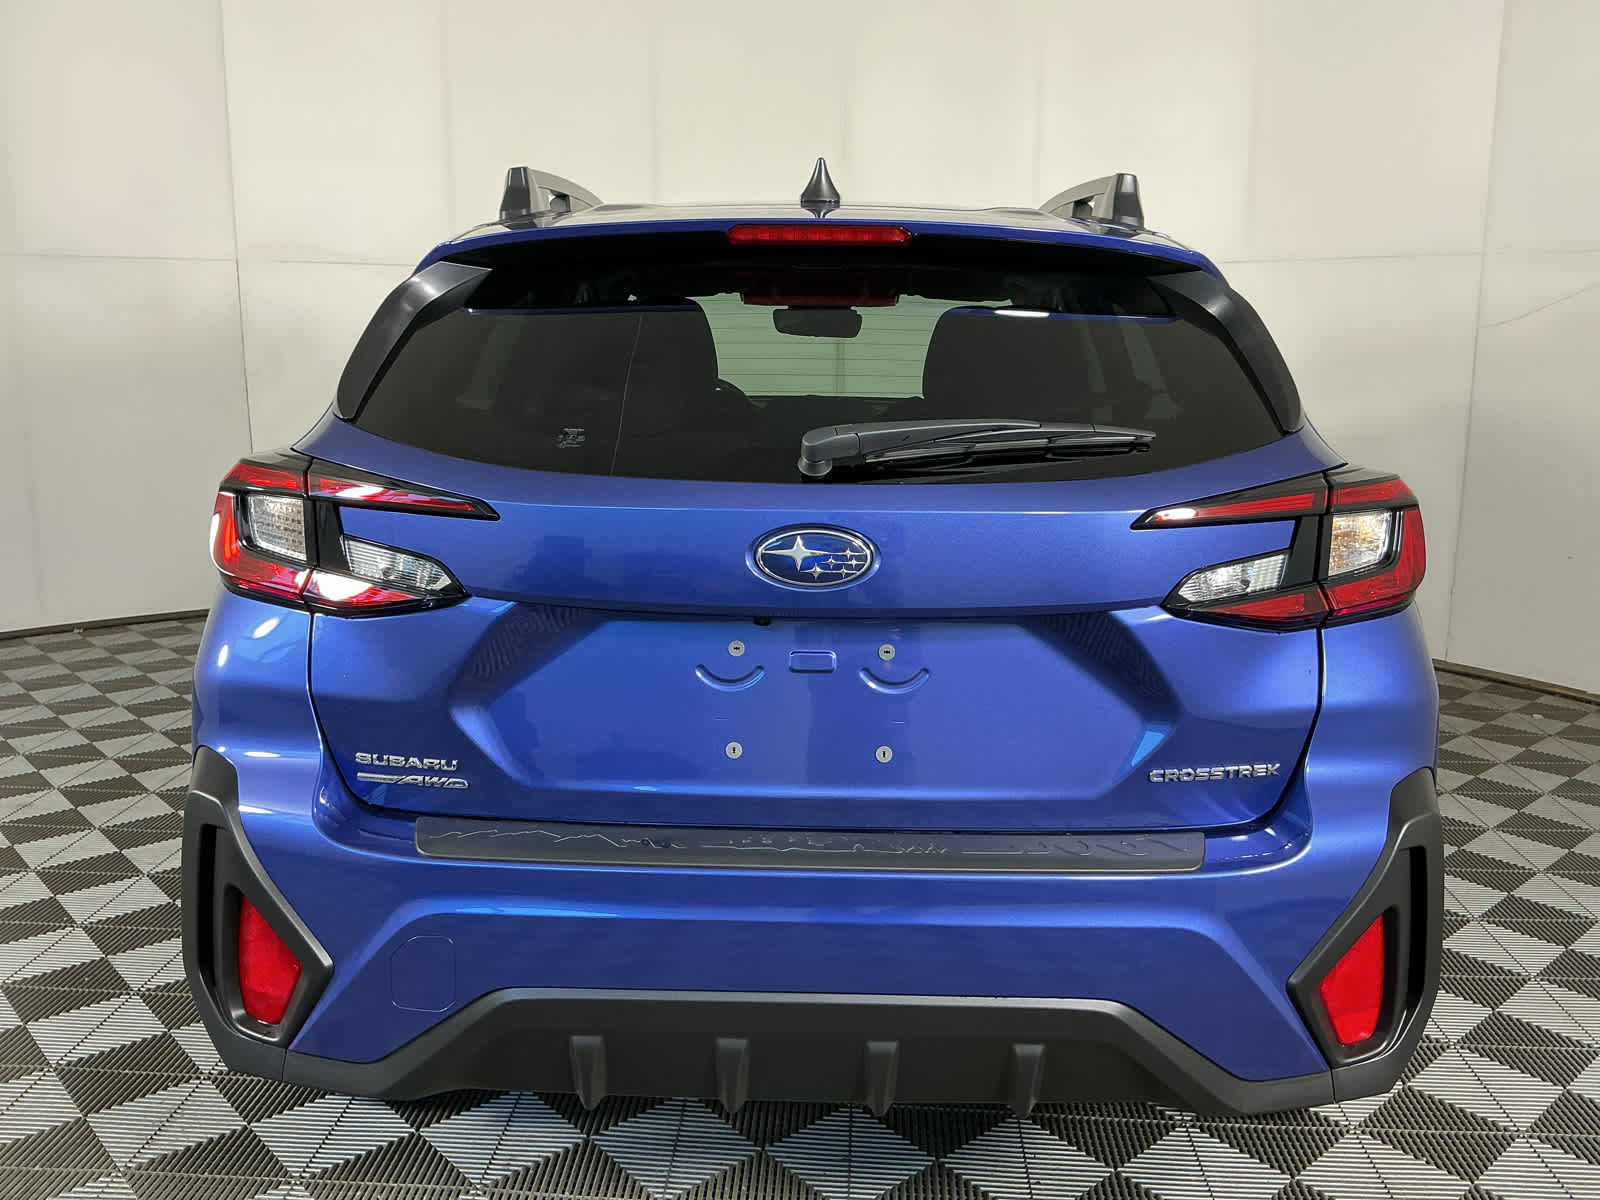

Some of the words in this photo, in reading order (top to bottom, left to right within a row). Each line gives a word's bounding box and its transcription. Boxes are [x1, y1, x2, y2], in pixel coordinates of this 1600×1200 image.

[355, 752, 458, 771] SUBARU
[397, 775, 469, 789] AWD
[1149, 763, 1281, 783] CROSSTREK
